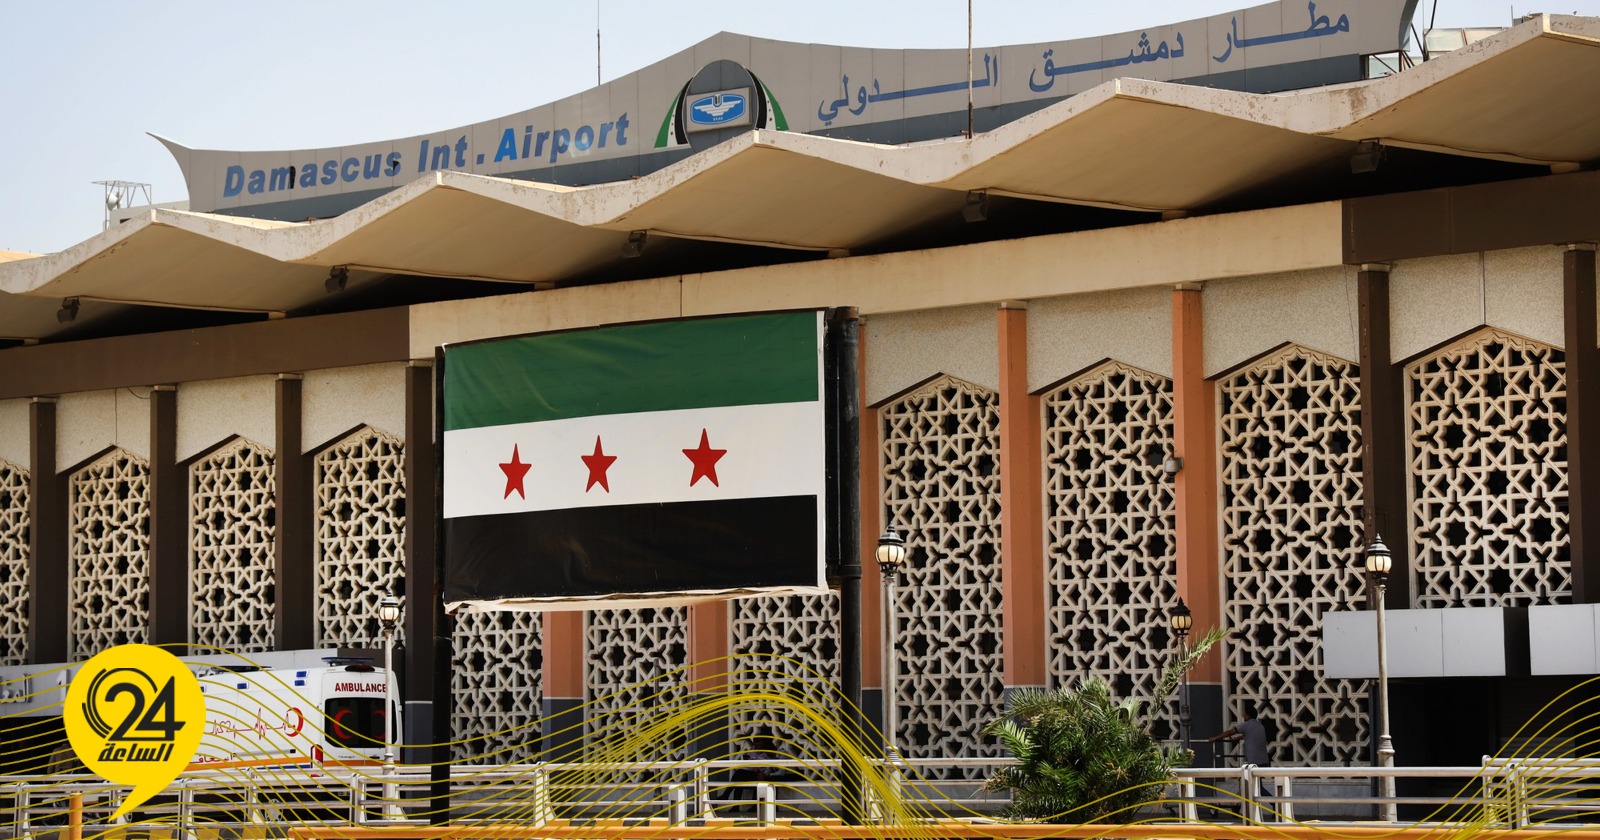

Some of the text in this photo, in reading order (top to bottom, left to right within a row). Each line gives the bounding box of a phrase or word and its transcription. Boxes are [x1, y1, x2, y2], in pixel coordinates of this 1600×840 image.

[817, 2, 1350, 124] مطار دمشق الدولي
[223, 152, 402, 198] Damascus
[494, 113, 630, 164] Airport
[334, 682, 387, 693] AMBULANCE
